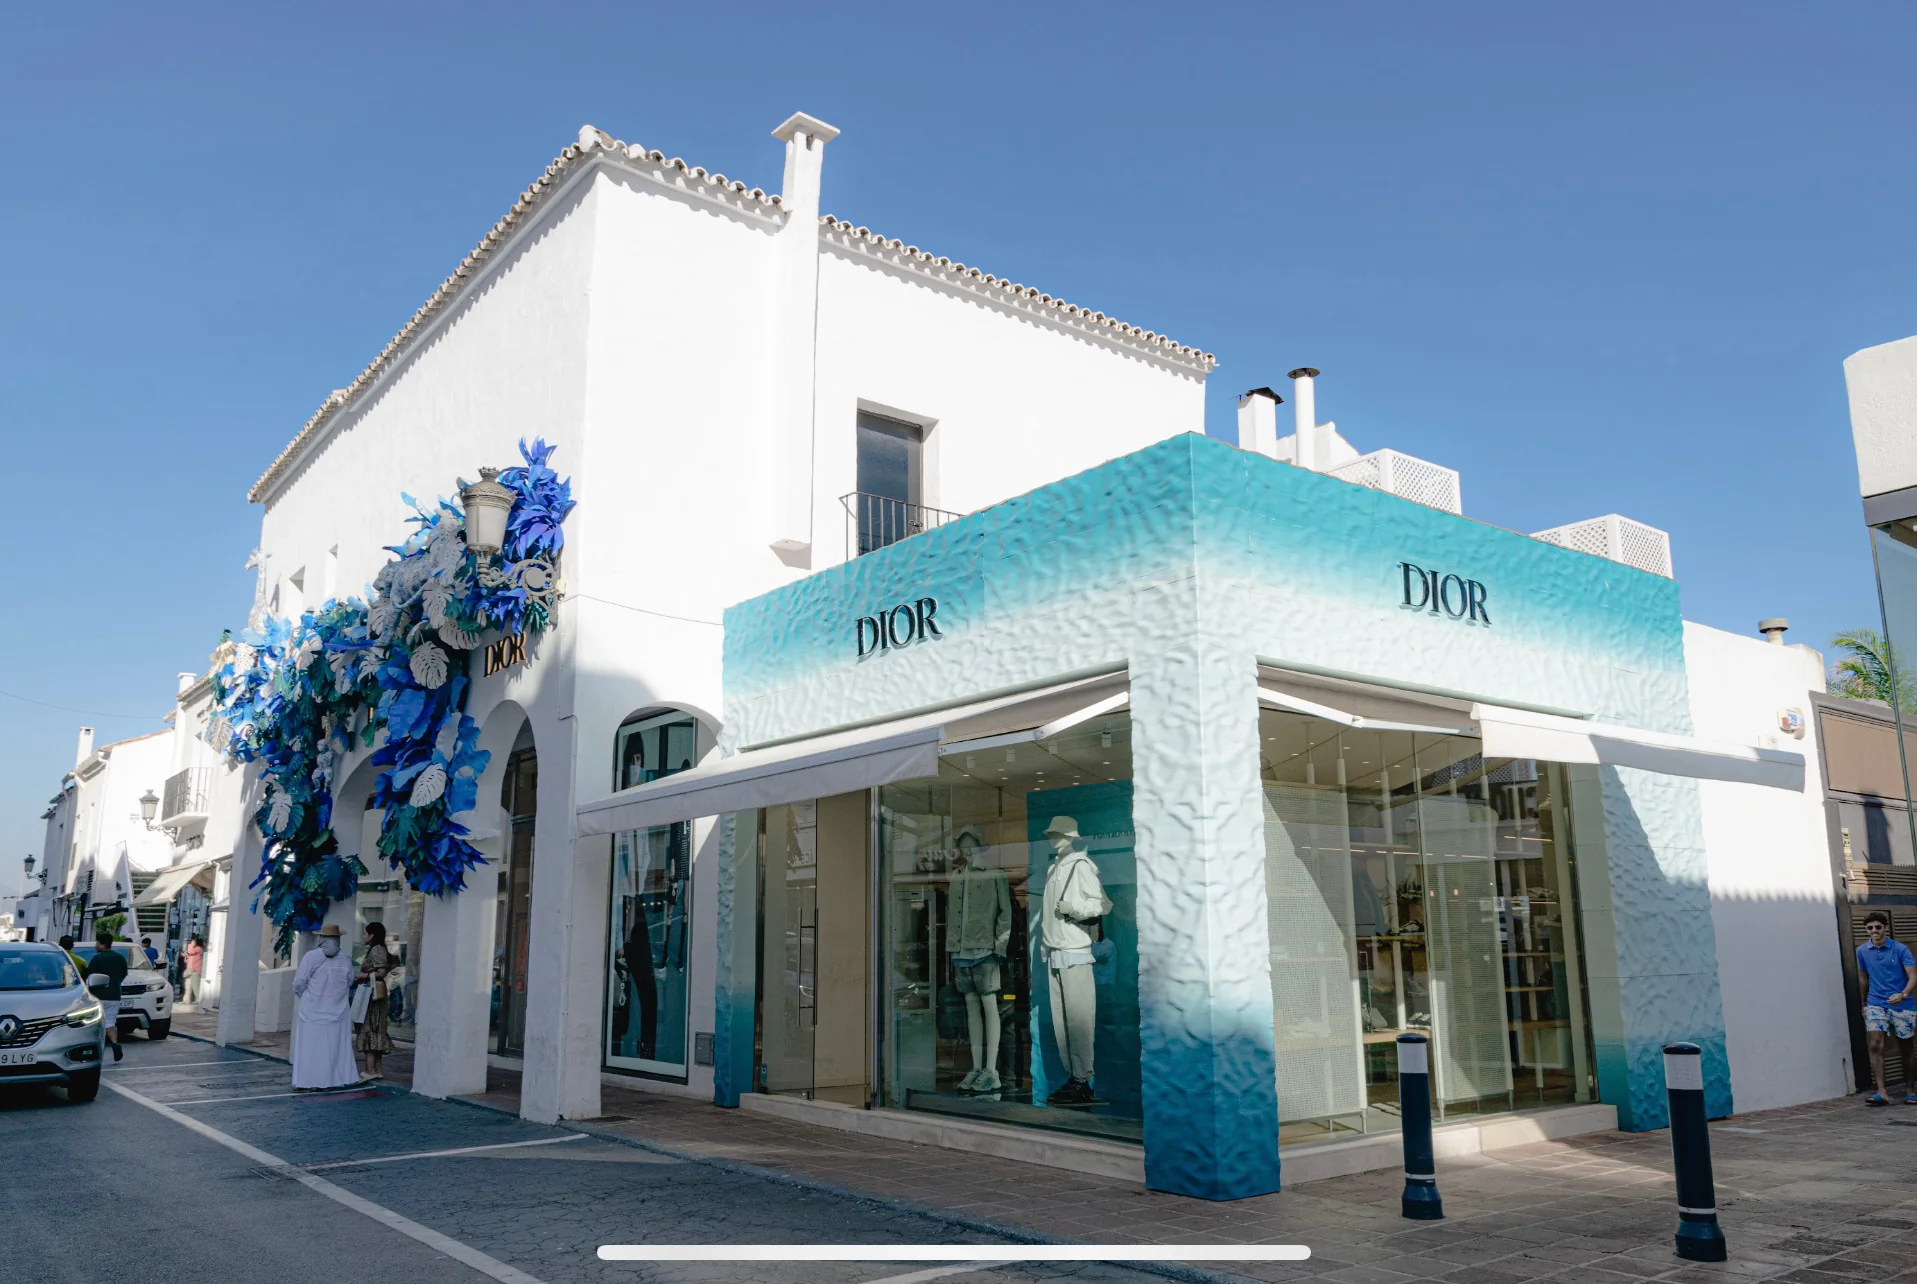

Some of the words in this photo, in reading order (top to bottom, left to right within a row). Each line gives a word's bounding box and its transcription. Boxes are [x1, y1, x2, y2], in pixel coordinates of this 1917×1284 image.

[1399, 561, 1492, 625] DIOR
[856, 597, 942, 657] DIOR
[11, 1053, 34, 1064] LYG
